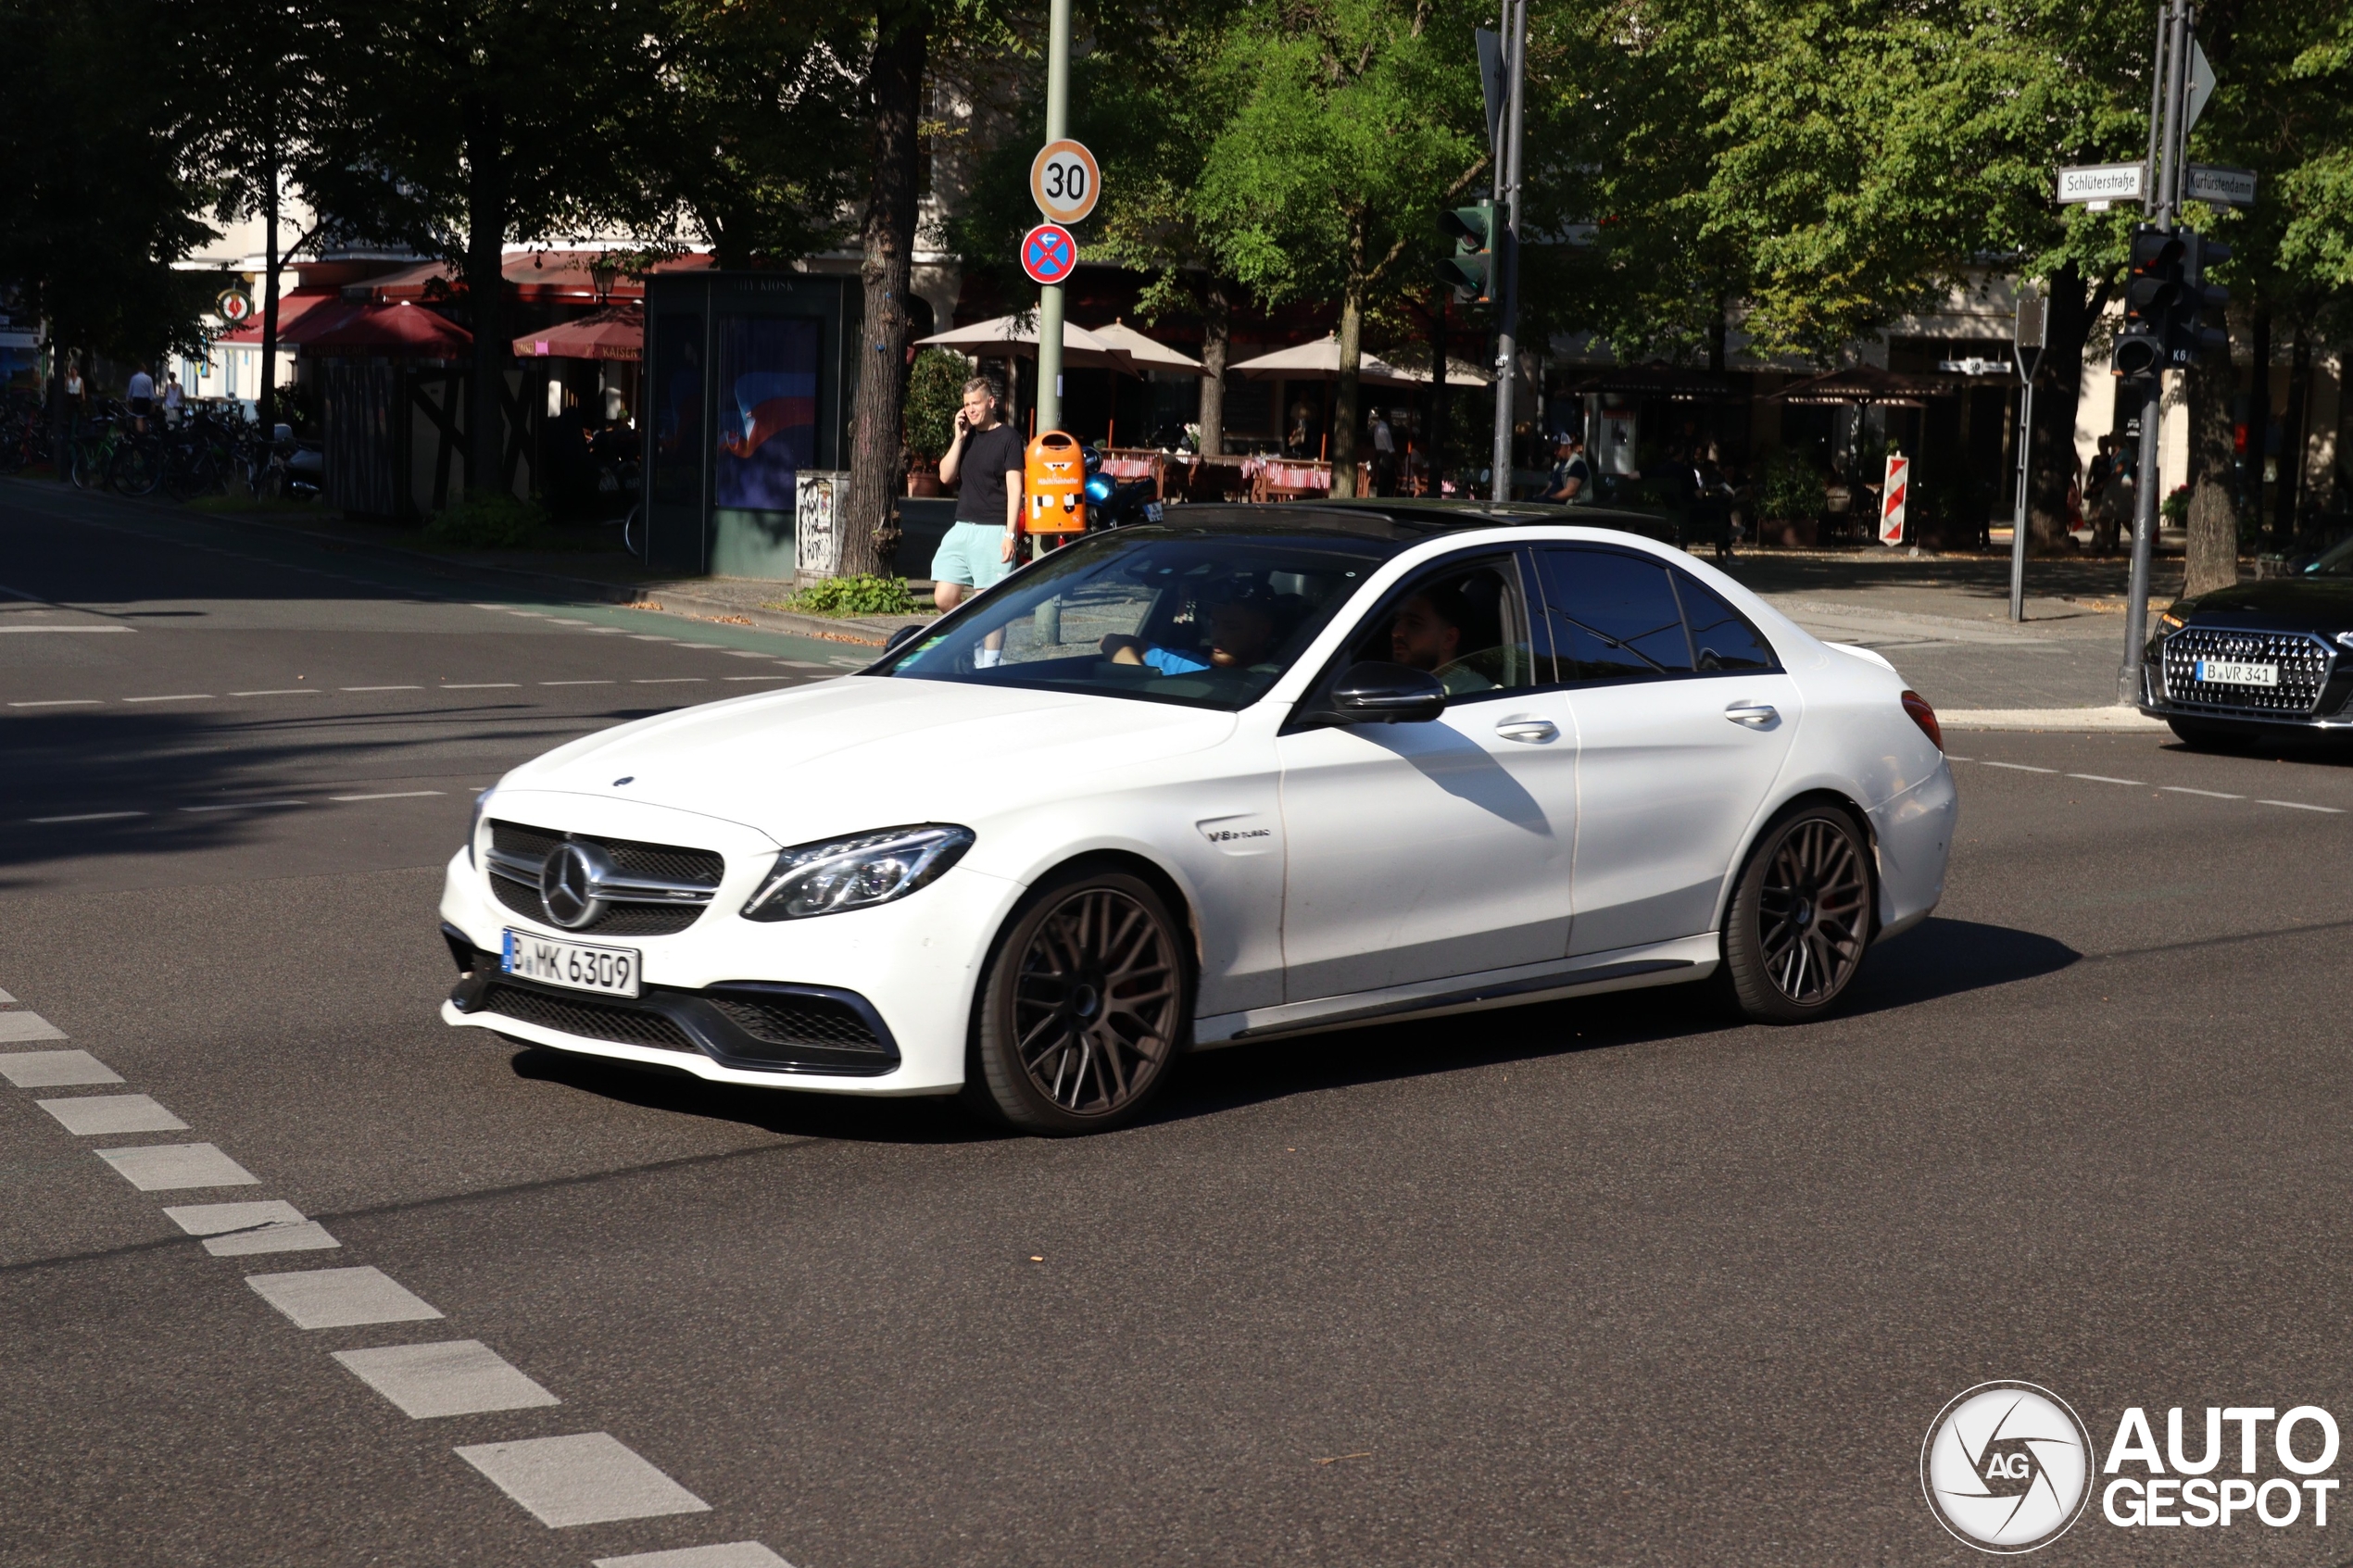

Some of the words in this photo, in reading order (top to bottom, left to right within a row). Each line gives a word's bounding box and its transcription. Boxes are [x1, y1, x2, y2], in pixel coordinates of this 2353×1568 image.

[1046, 162, 1085, 200] 30
[2067, 172, 2135, 192] Schlüterstraße
[2189, 171, 2252, 194] Kurfürstendamm
[761, 279, 794, 293] KIOSK
[308, 346, 341, 357] KAISER
[602, 346, 637, 358] KAISER
[2172, 349, 2186, 361] K6
[2208, 664, 2216, 679] B
[2225, 665, 2241, 681] VR
[2245, 667, 2270, 683] 341
[1208, 831, 1230, 842] V8
[569, 949, 630, 989] 6309
